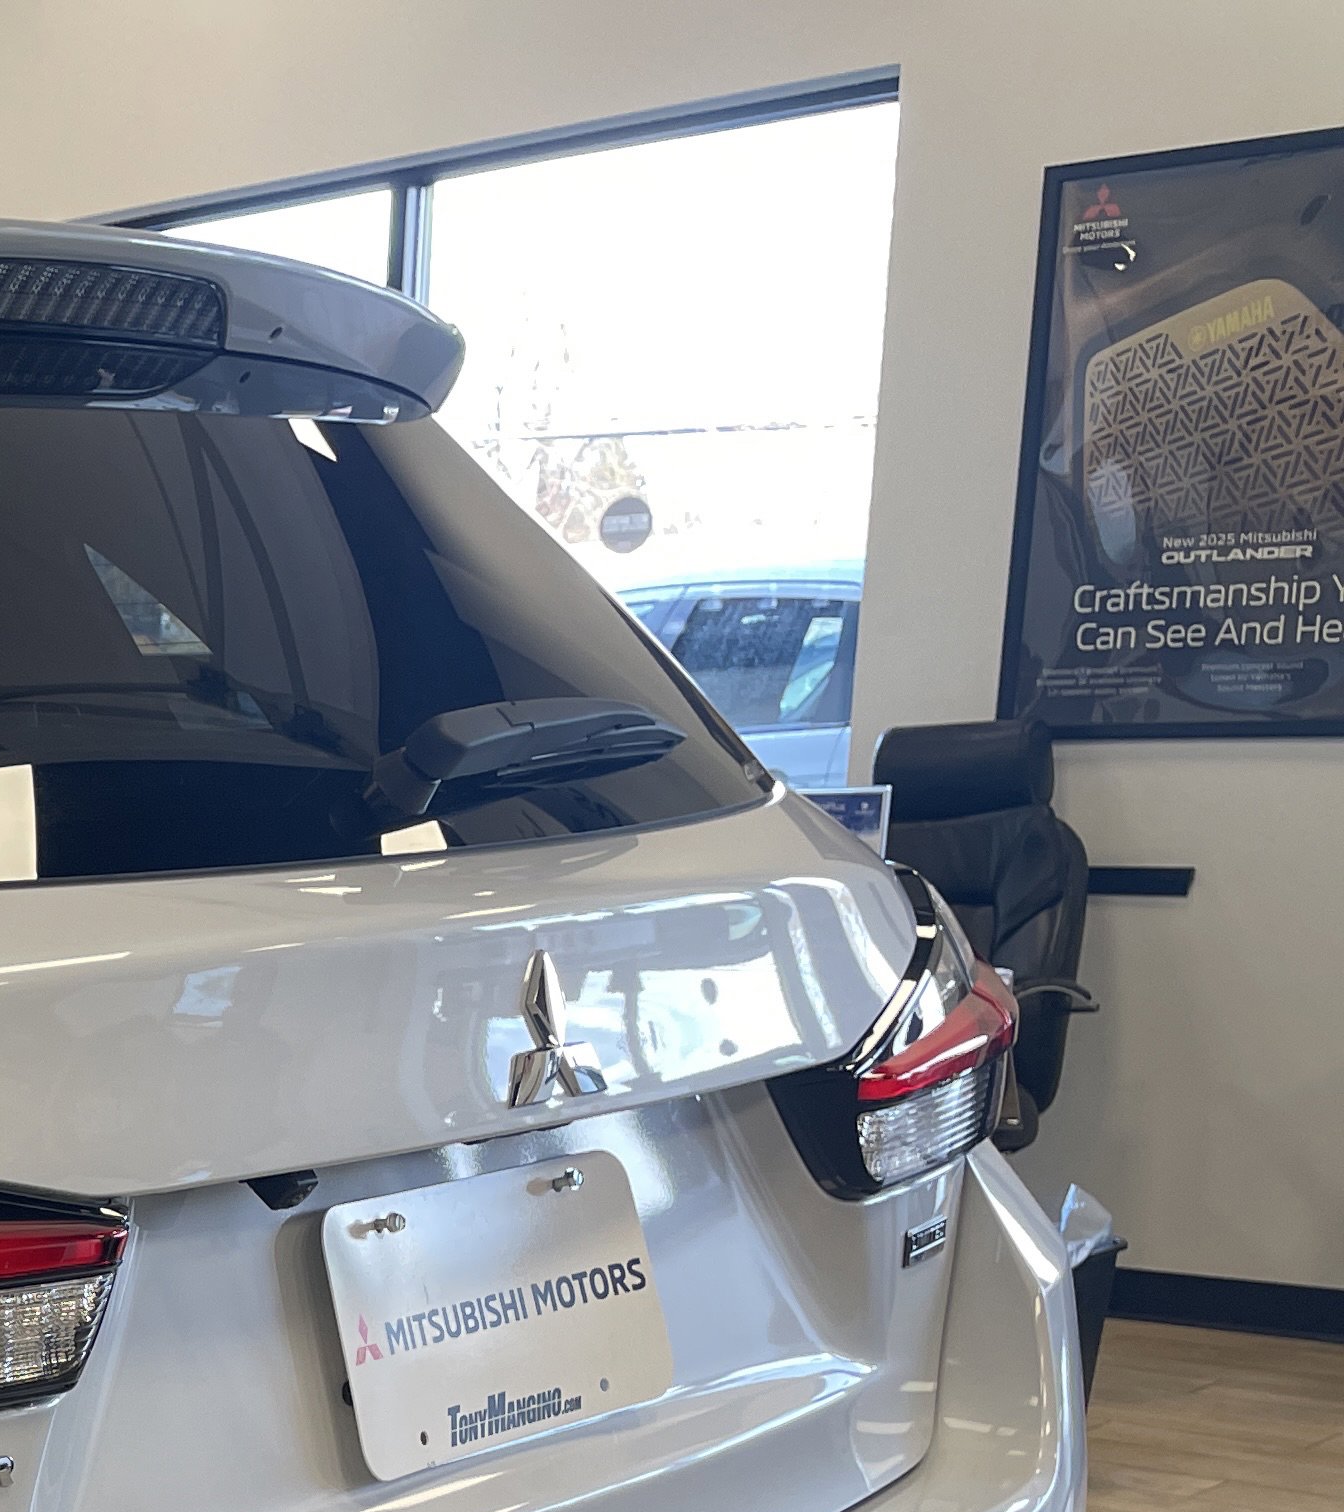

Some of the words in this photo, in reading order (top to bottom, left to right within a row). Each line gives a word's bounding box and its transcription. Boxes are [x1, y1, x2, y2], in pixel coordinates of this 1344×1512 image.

[1080, 229, 1120, 240] MOTORS
[1206, 295, 1276, 343] YAMAHA
[1161, 544, 1314, 566] OUTLANDER
[1163, 536, 1195, 549] New
[1198, 533, 1236, 547] 2025
[1239, 528, 1318, 544] Mitsubishi
[1073, 575, 1321, 615] Craftsmanship
[1075, 622, 1137, 651] Can
[1144, 619, 1207, 649] See
[1213, 613, 1286, 647] And
[1295, 614, 1344, 645] He
[384, 1287, 529, 1356] MITSUBISHI
[530, 1257, 647, 1315] MOTORS
